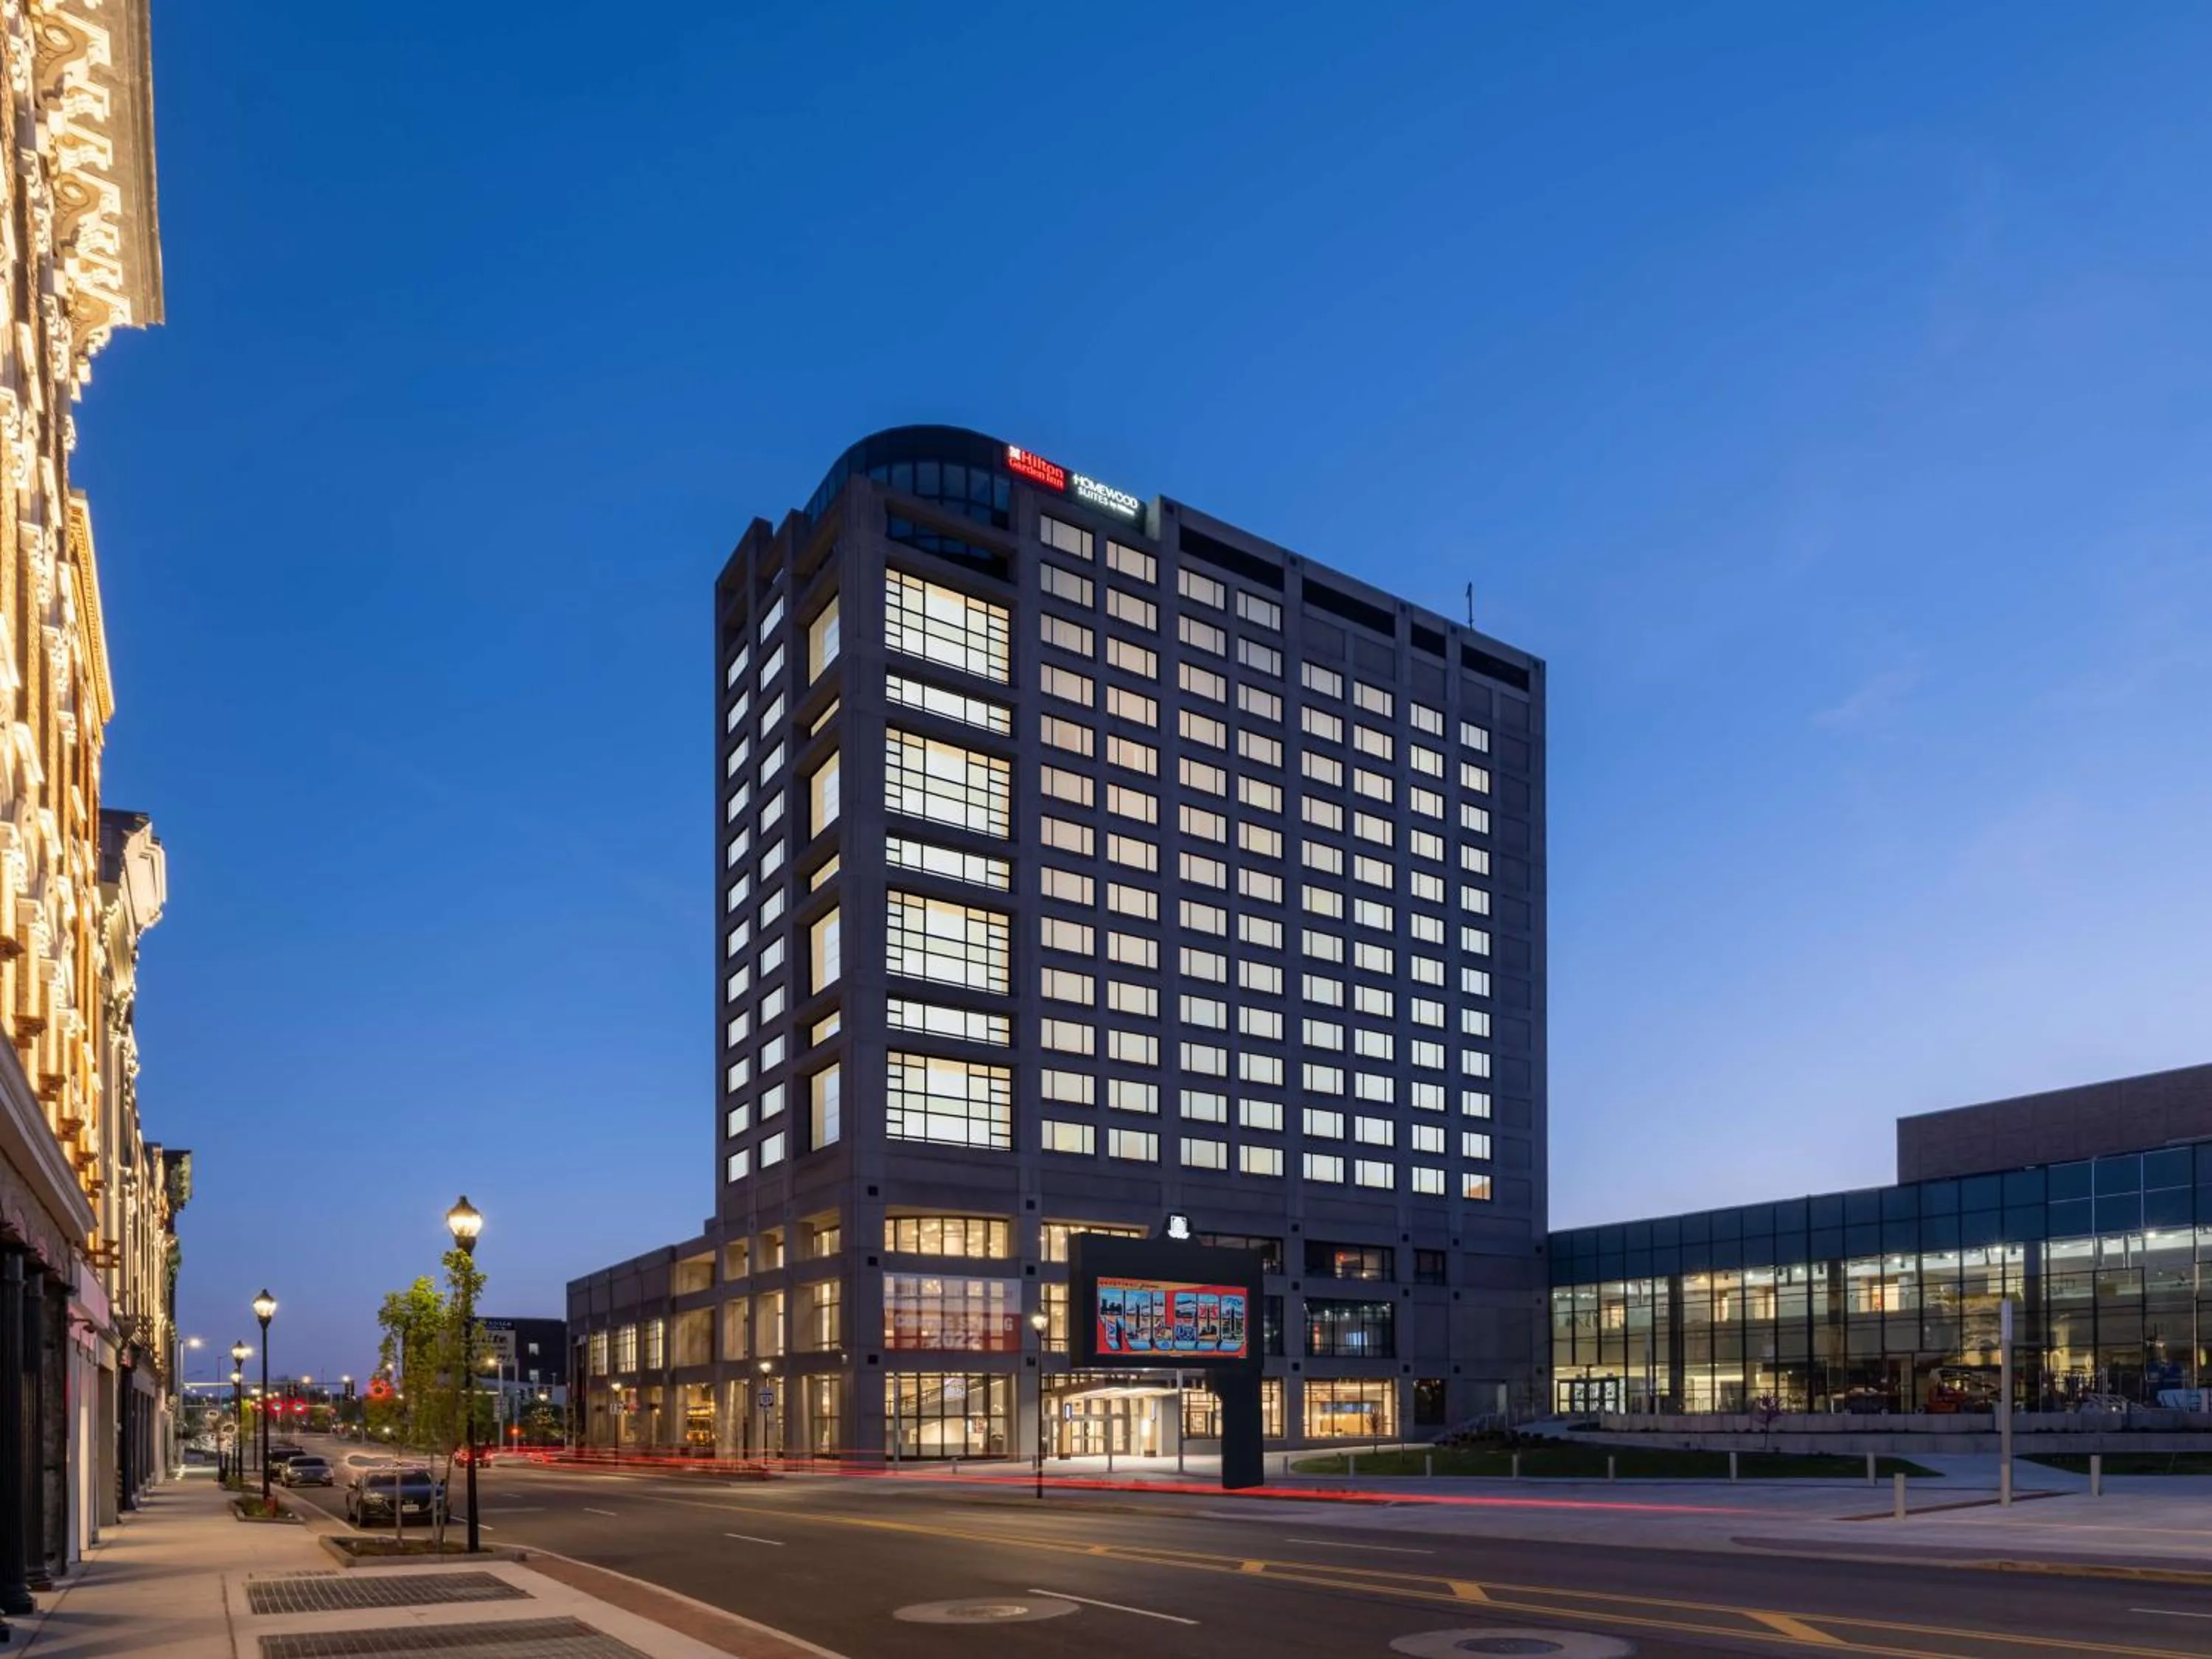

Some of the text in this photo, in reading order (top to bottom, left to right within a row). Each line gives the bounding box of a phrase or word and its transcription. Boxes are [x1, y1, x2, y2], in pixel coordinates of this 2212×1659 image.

[1009, 458, 1064, 490] Garden Inn
[1021, 451, 1064, 479] Hilton
[1073, 473, 1138, 509] HOMEWOOD
[1077, 486, 1109, 507] SUITES
